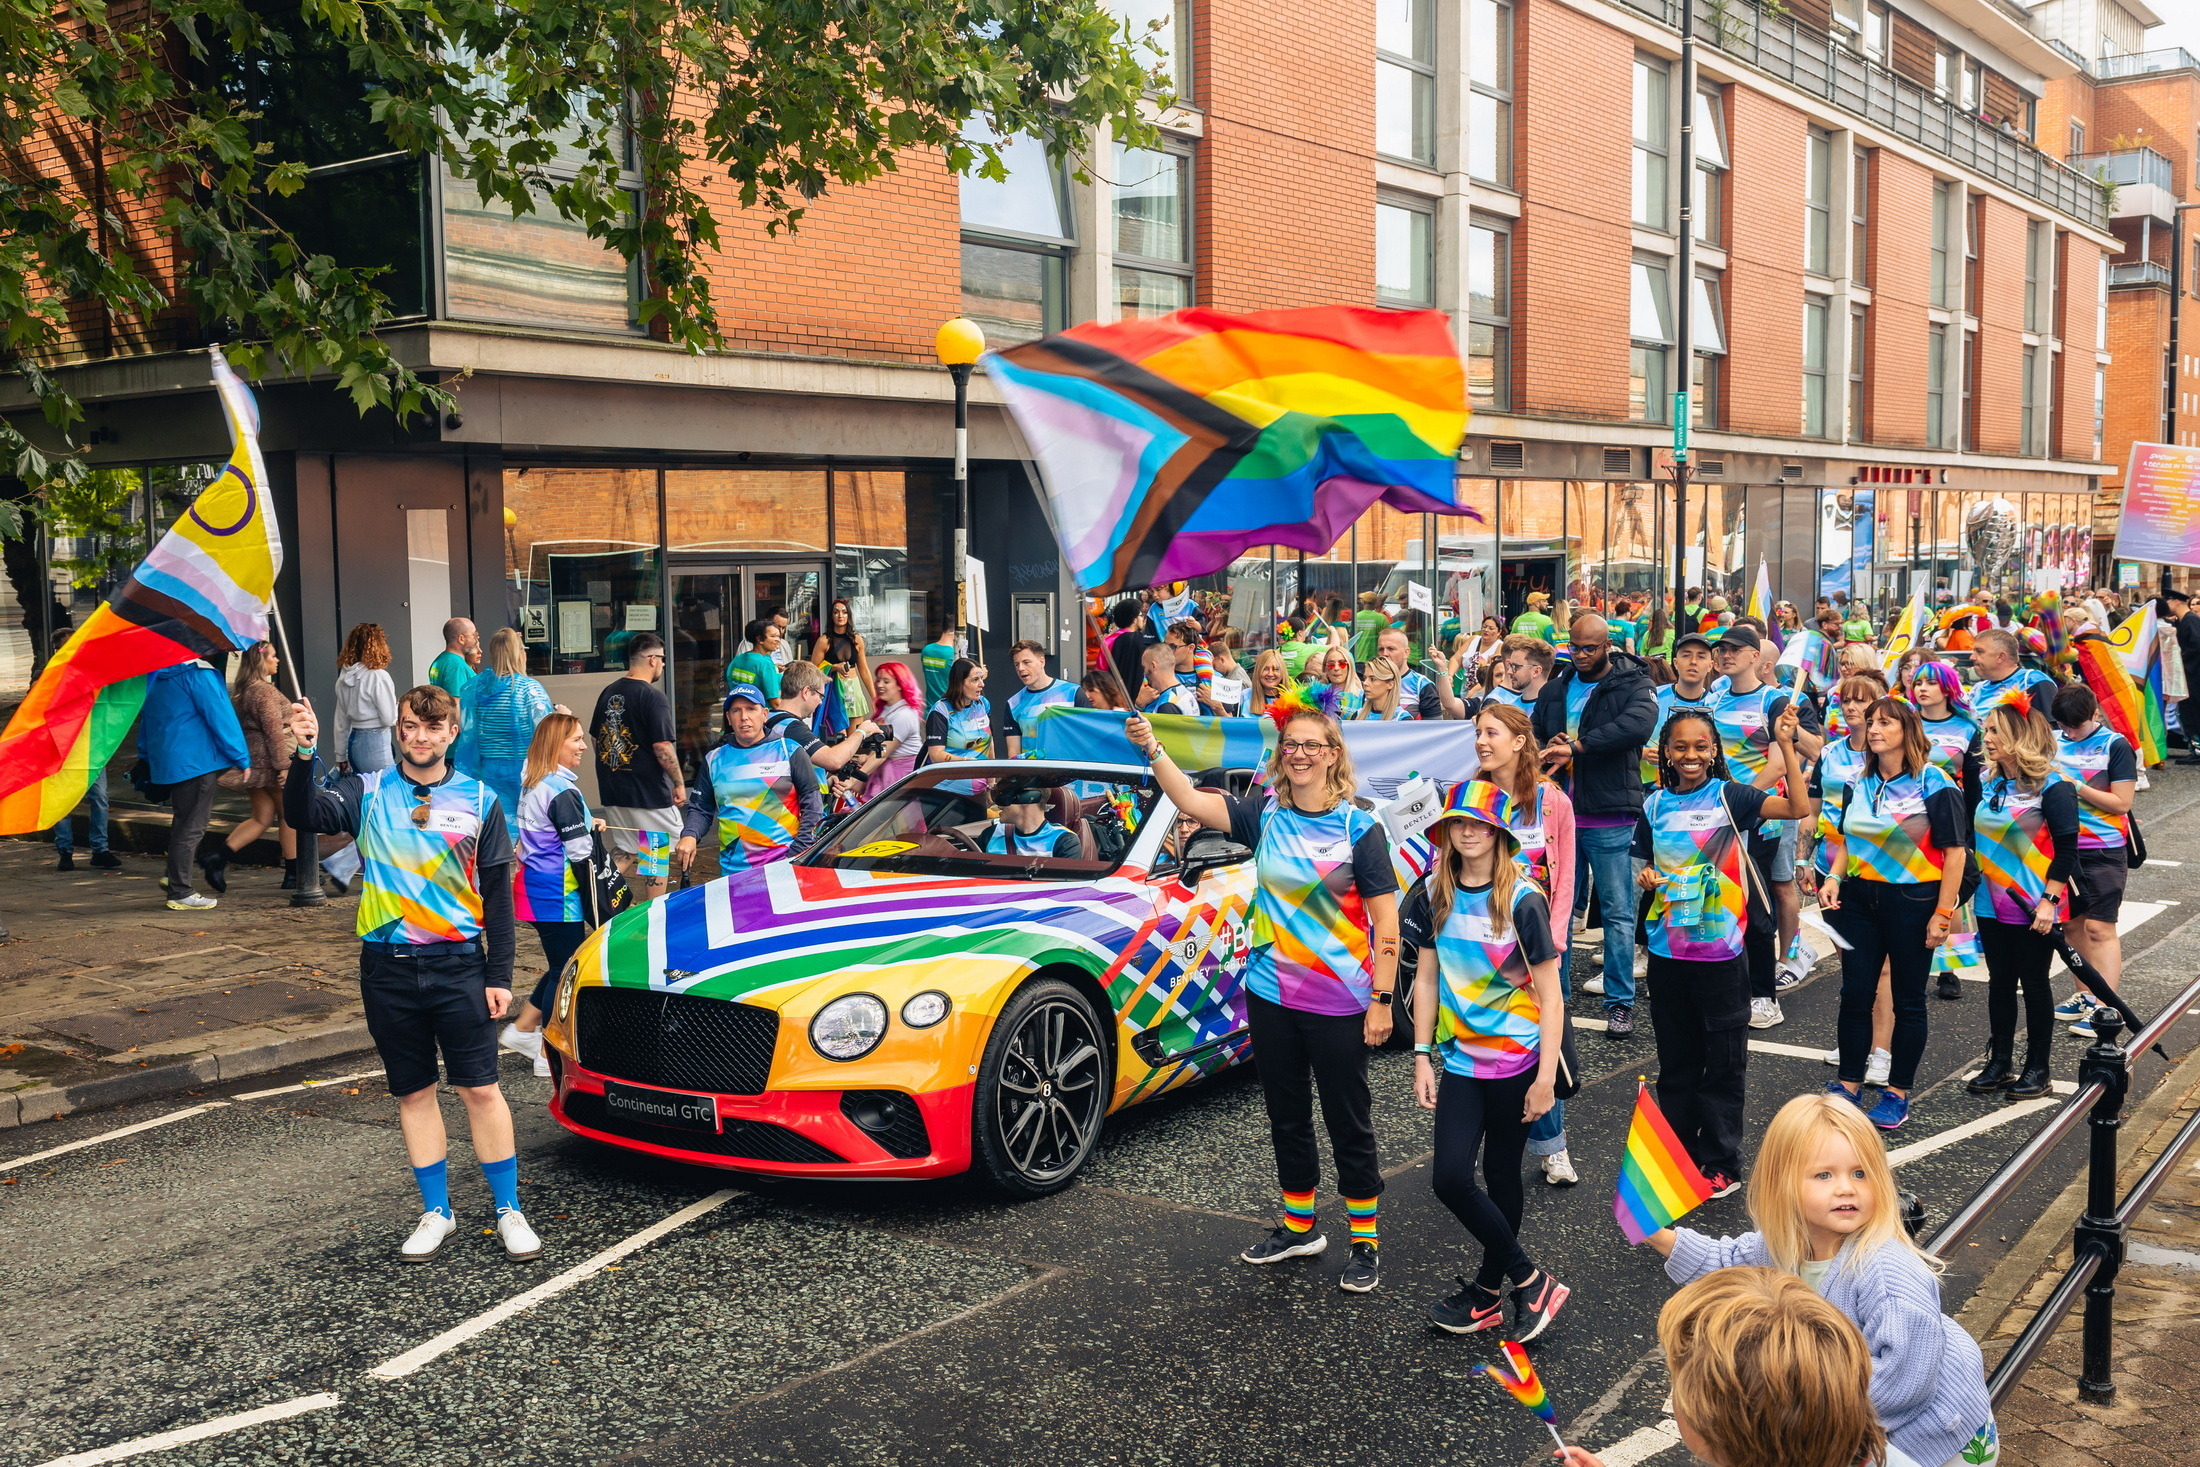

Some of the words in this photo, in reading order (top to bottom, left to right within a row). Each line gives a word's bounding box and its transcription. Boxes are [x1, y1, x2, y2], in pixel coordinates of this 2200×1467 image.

[1215, 691, 1239, 699] BENTLEY
[1403, 808, 1437, 830] BENTLEY
[1169, 966, 1211, 988] BENTLEY
[608, 1092, 677, 1117] Continental
[681, 1105, 711, 1122] GTC
